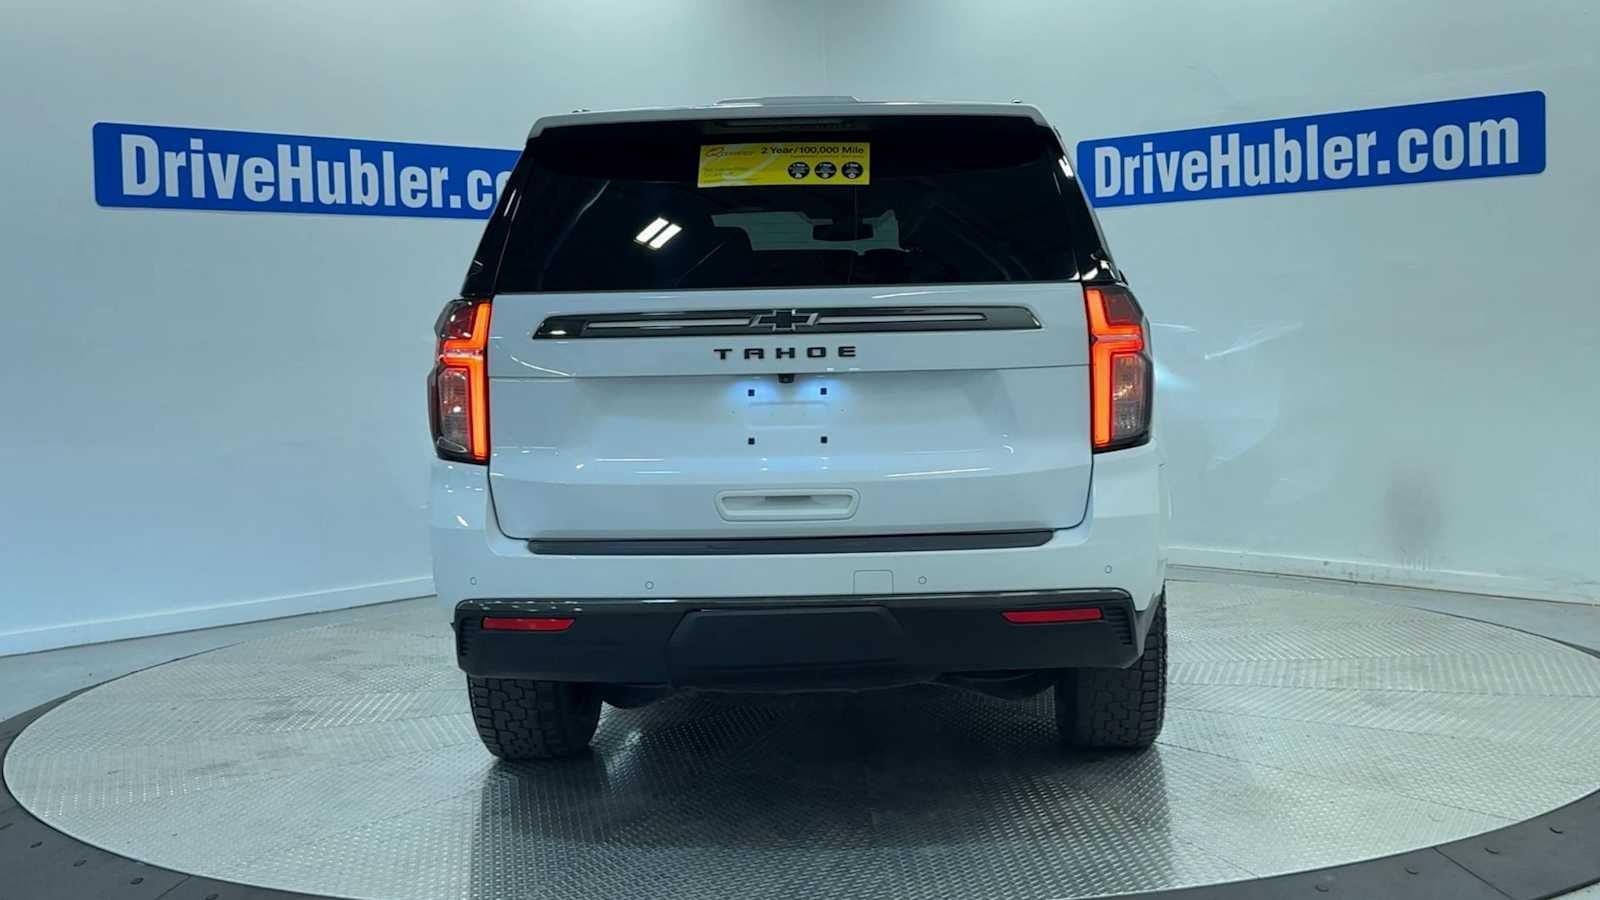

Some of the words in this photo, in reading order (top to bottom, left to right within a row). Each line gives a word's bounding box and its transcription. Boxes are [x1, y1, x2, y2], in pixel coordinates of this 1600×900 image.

[760, 146, 769, 155] 2
[770, 146, 840, 156] Year/100,000
[841, 146, 865, 155] Mile
[1094, 116, 1519, 198] DriveHubler.com
[713, 345, 857, 360] TAHOE
